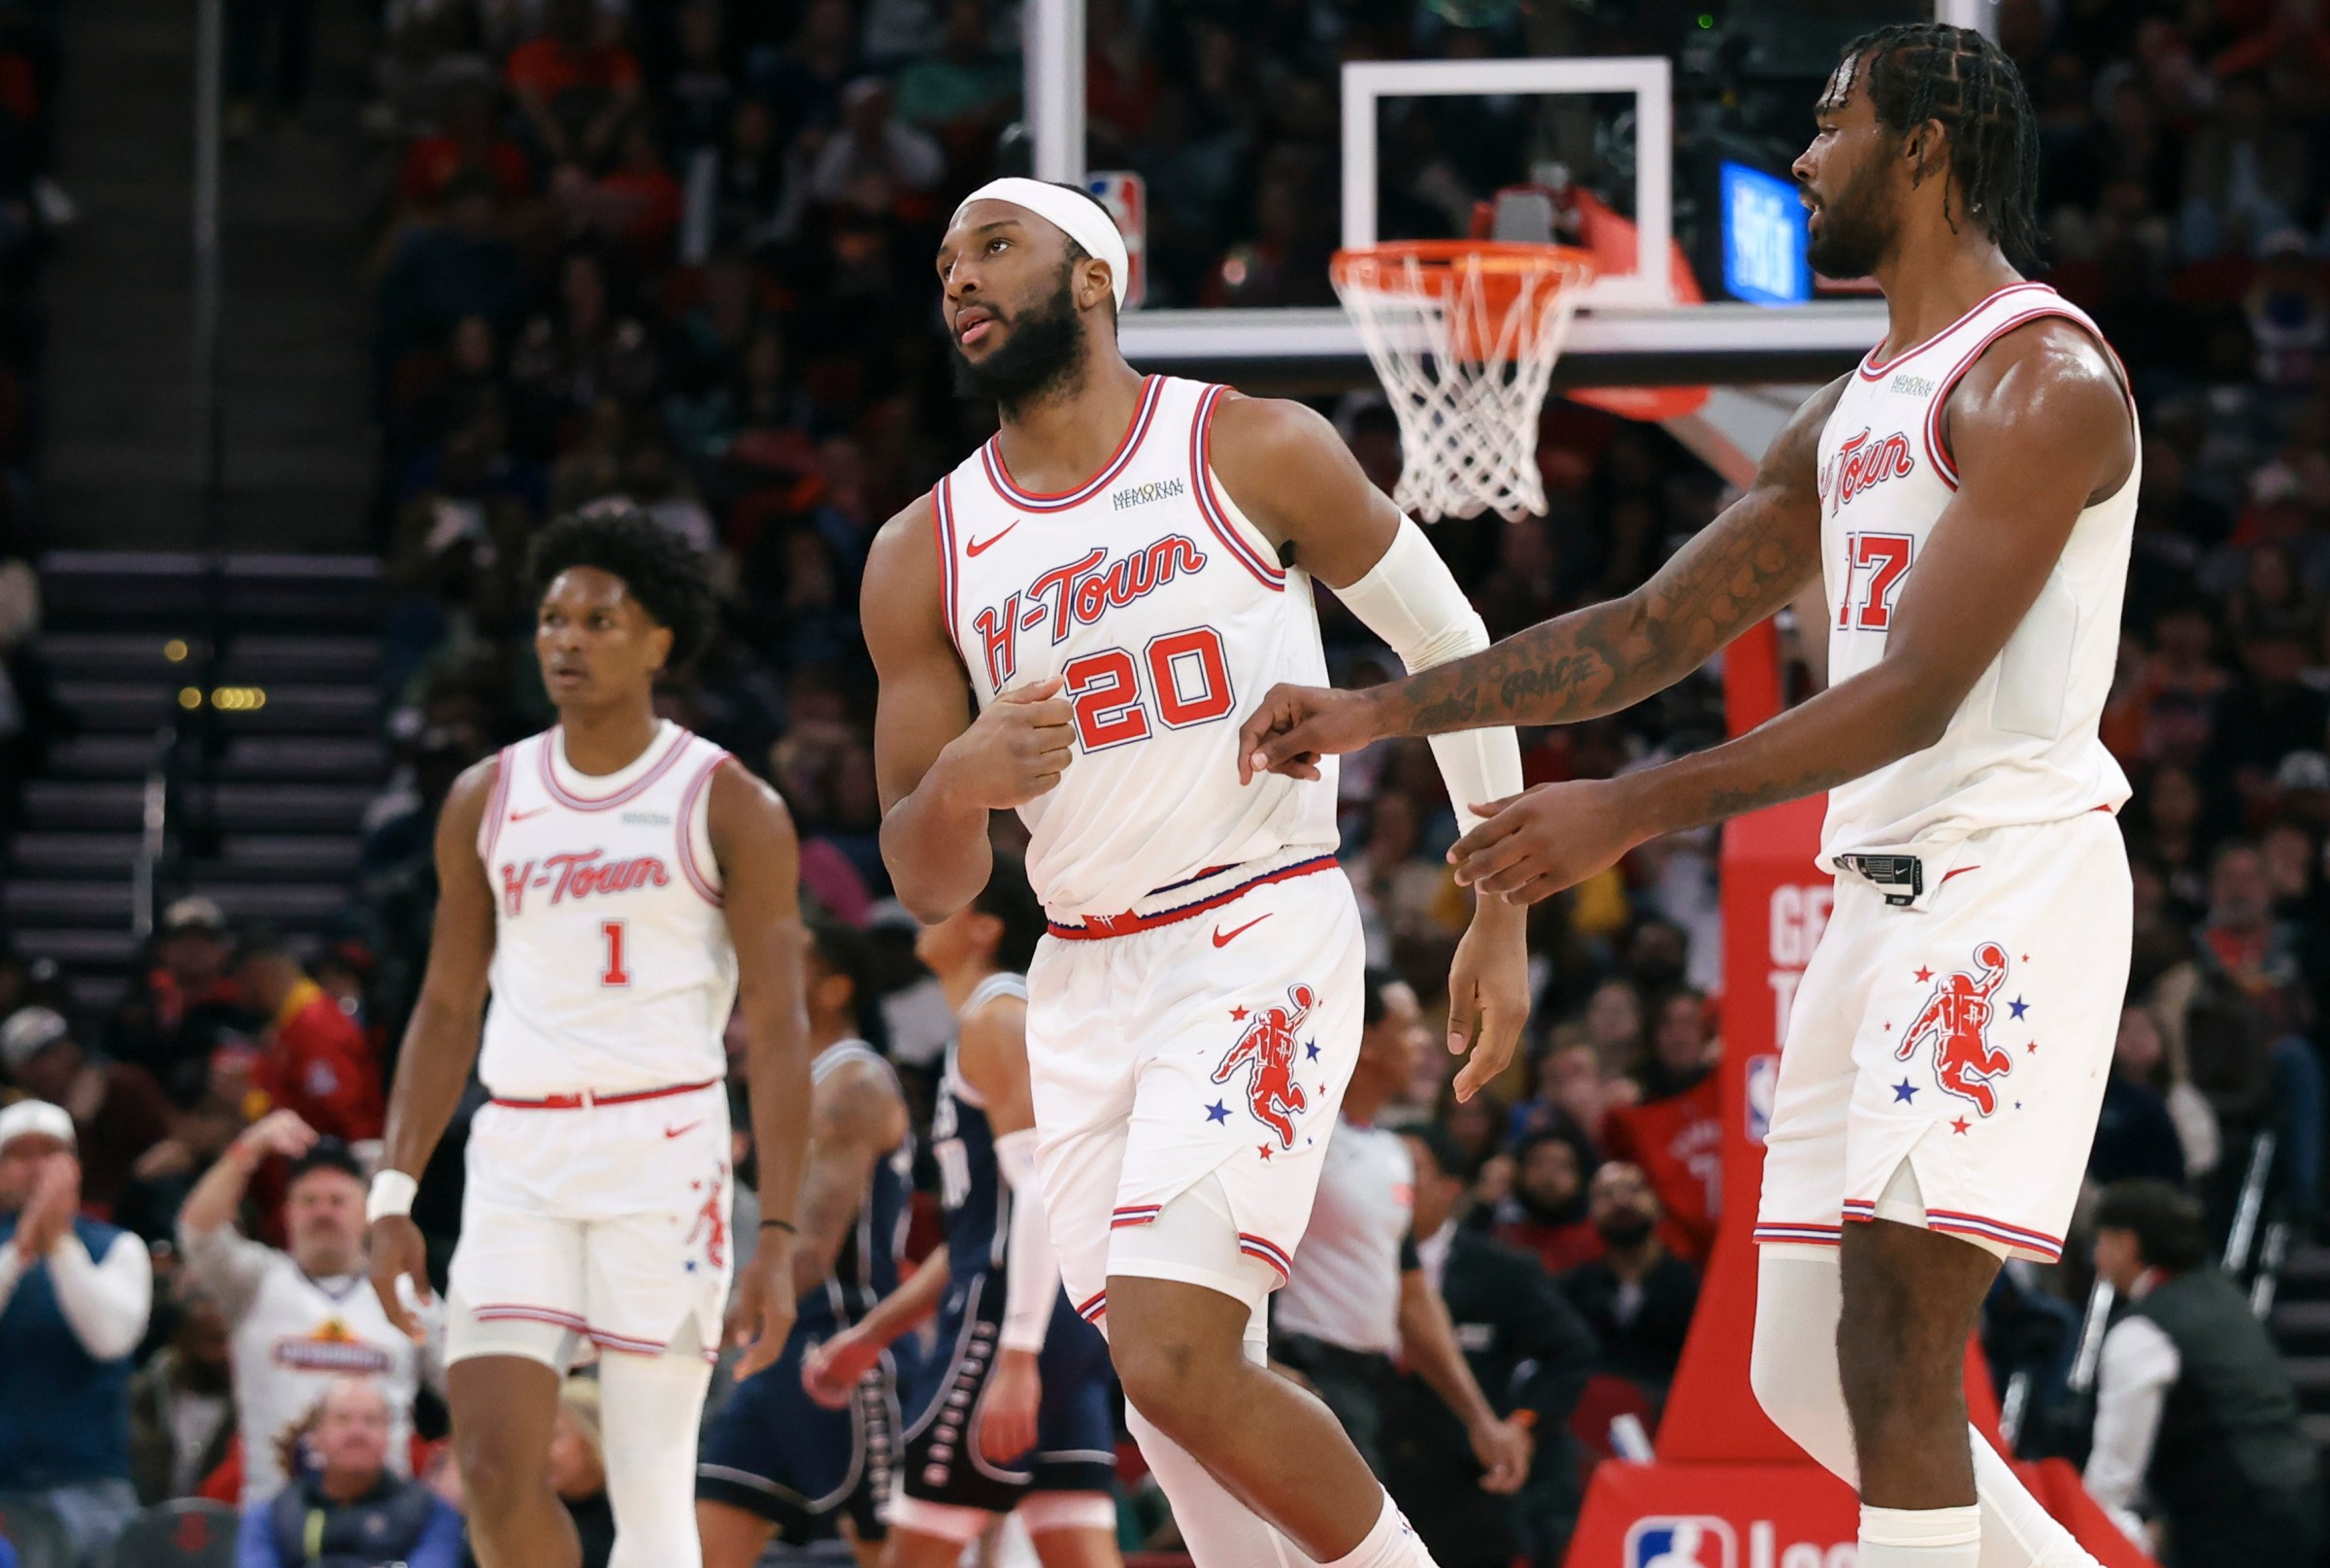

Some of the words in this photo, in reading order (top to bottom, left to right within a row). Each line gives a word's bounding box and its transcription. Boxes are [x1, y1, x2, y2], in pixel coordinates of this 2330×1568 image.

[1113, 478, 1183, 502] MEMORIAL
[1114, 484, 1183, 512] HERMANN
[973, 533, 1207, 696] H-Town
[1837, 531, 1914, 631] 17
[1060, 624, 1236, 754] 20
[501, 847, 672, 917] H-Town
[601, 918, 630, 987] 1
